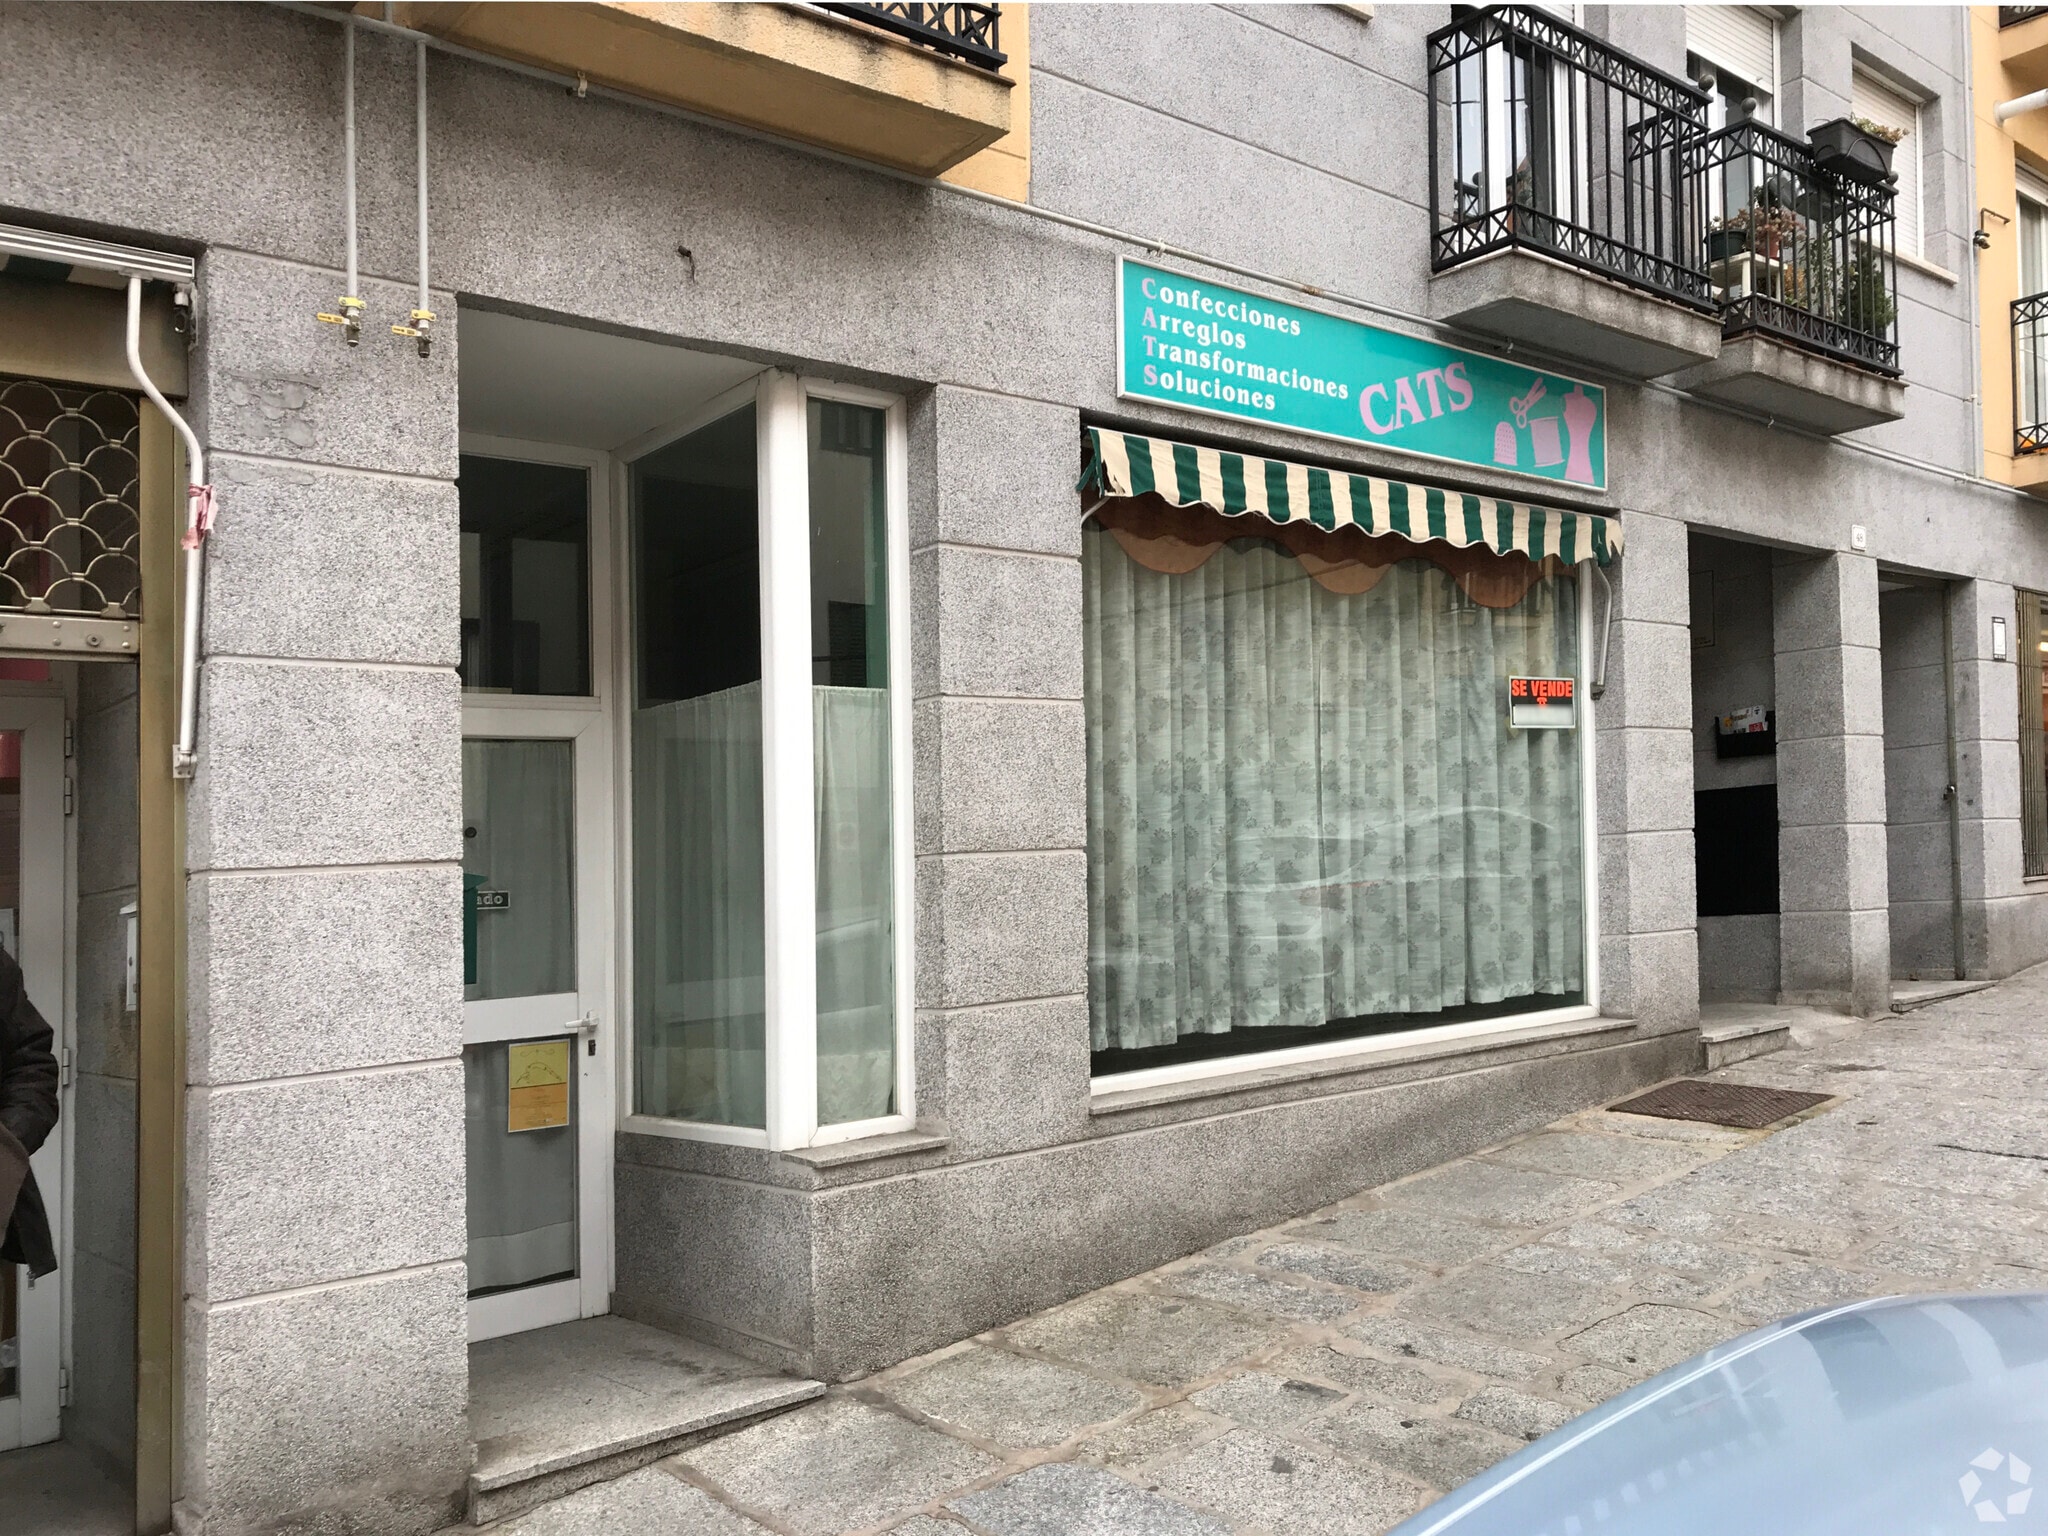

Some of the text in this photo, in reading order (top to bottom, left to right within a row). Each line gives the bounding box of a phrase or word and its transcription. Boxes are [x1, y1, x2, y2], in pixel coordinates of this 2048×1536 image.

[1141, 277, 1301, 336] Confecciones
[1141, 306, 1247, 349] Arreglos
[1142, 334, 1349, 400] Transformaciones
[1143, 364, 1276, 411] Soluciones
[1359, 362, 1474, 435] CATS
[1511, 680, 1573, 698] SE VENDE
